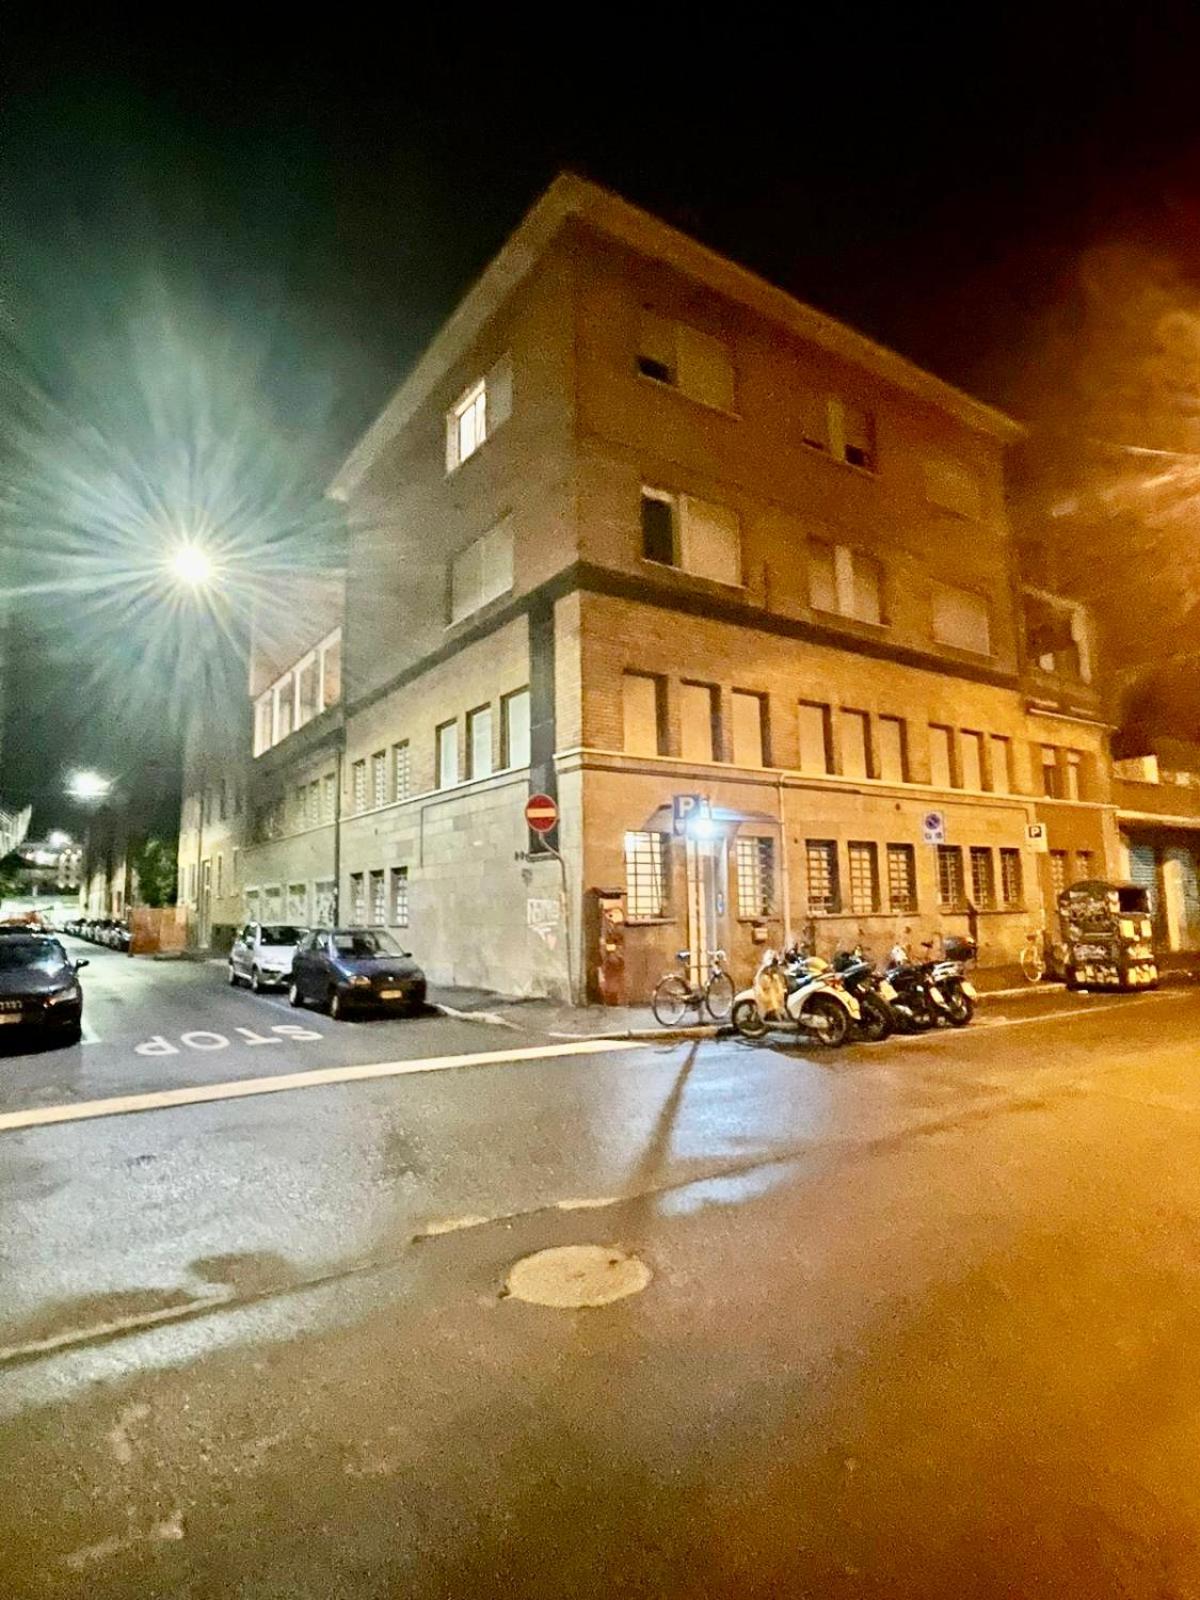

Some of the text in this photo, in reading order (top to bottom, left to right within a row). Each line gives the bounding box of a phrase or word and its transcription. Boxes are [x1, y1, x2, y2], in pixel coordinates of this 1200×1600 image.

[679, 797, 694, 817] P
[1030, 826, 1041, 838] P
[134, 1025, 324, 1056] STOP
